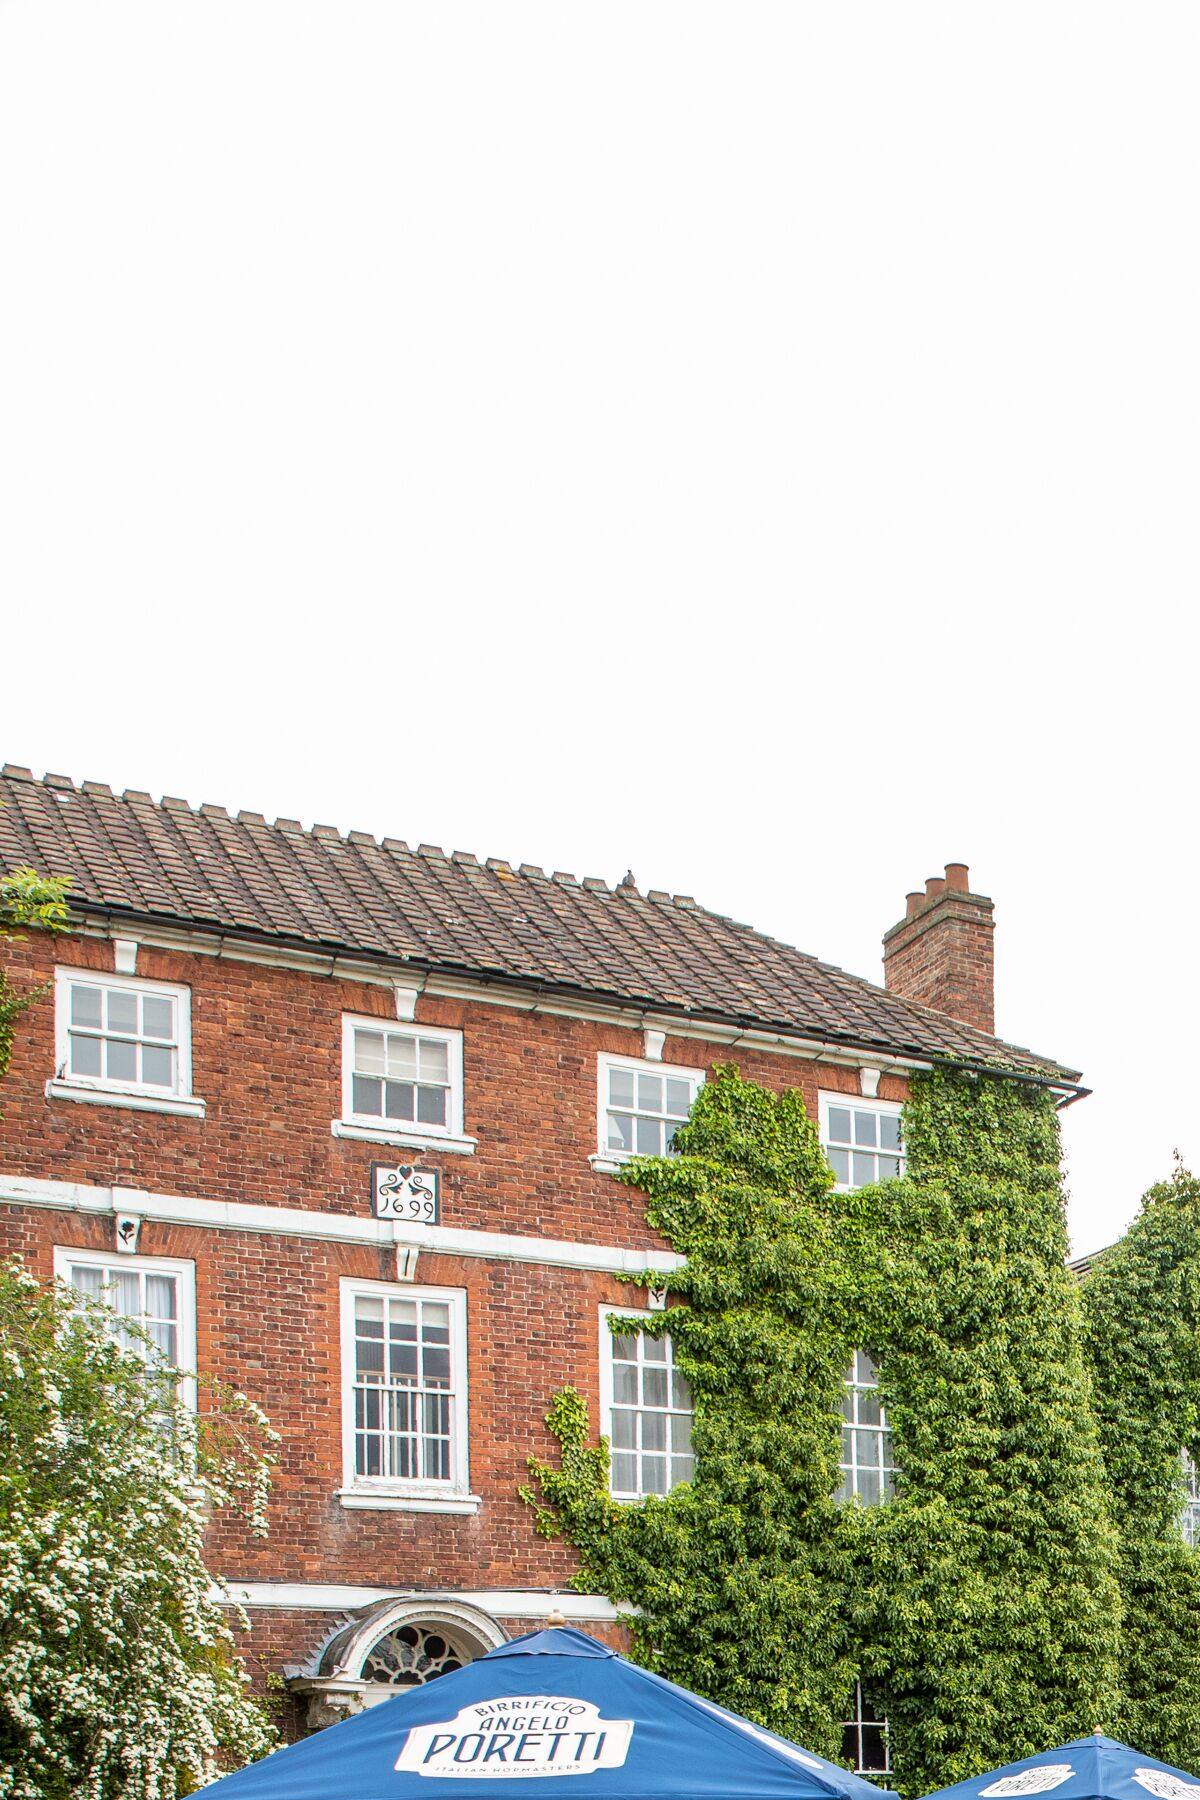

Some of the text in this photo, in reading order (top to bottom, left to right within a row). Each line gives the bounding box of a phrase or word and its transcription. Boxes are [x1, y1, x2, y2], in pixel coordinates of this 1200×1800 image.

[379, 1198, 434, 1220] 1699
[474, 1700, 587, 1717] BIRRIFICIO
[479, 1716, 569, 1731] ANGELO
[422, 1732, 607, 1764] PORETTI
